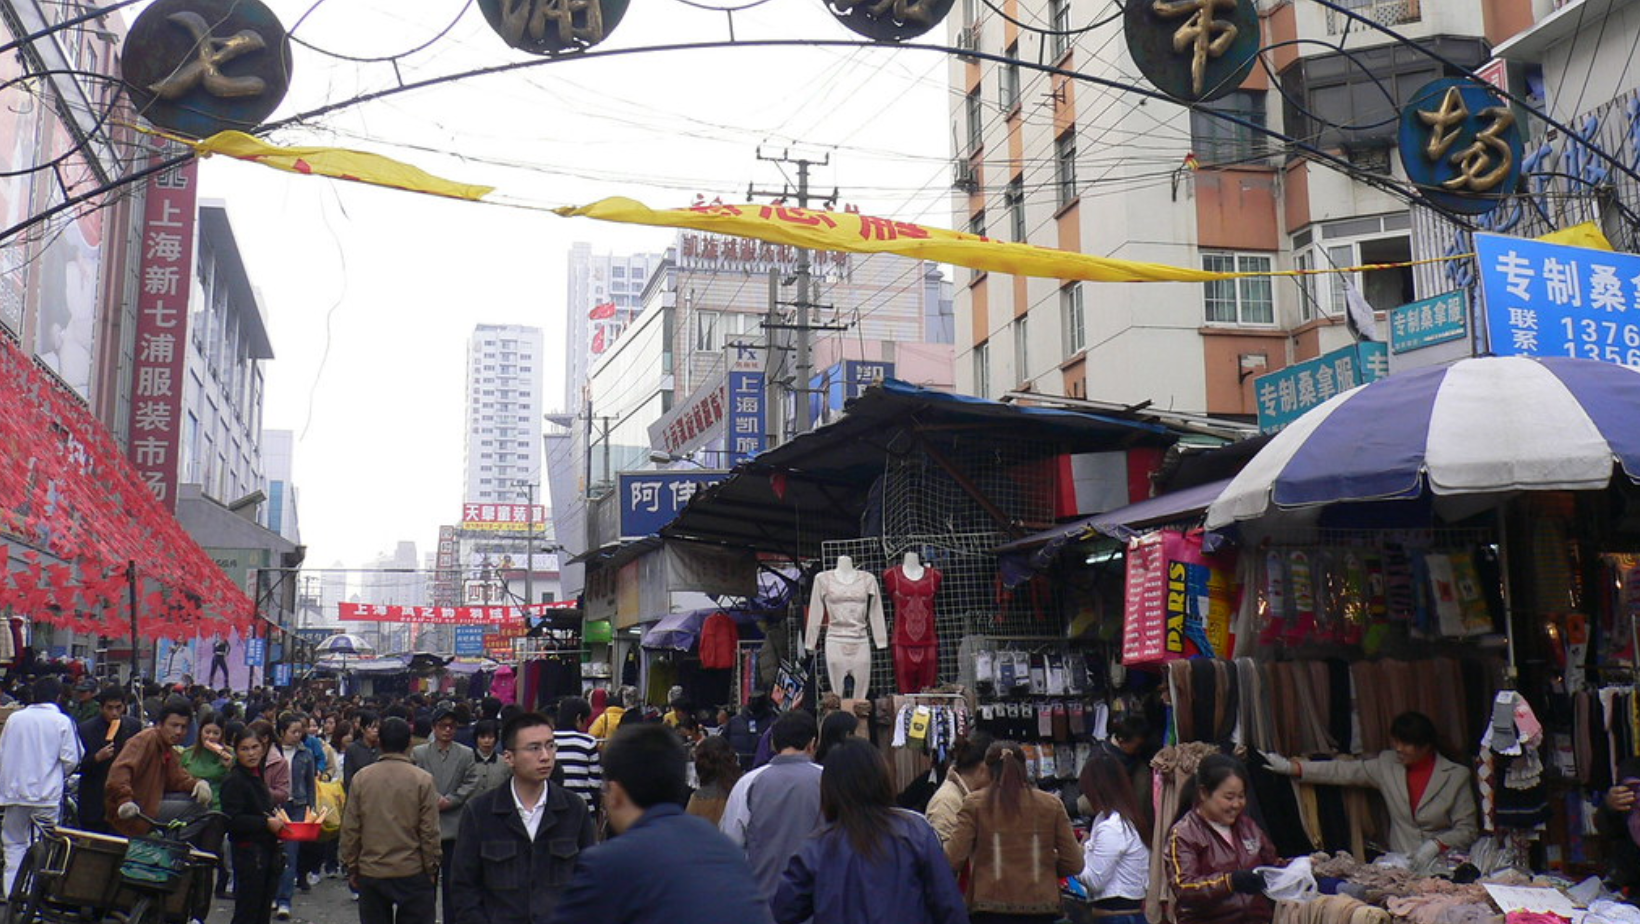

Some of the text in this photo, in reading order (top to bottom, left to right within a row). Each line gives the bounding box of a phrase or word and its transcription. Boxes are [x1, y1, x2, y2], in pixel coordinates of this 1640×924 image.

[1417, 87, 1515, 191] 场
[134, 198, 184, 501] 上海新七浦服装市场
[1394, 297, 1464, 337] 专制桑拿服
[1508, 307, 1539, 357] 联系
[736, 376, 759, 468] 上海凯旋
[1260, 357, 1355, 417] 专制桑拿服
[631, 480, 720, 512] 阿伟
[1167, 562, 1186, 652] PARIS
